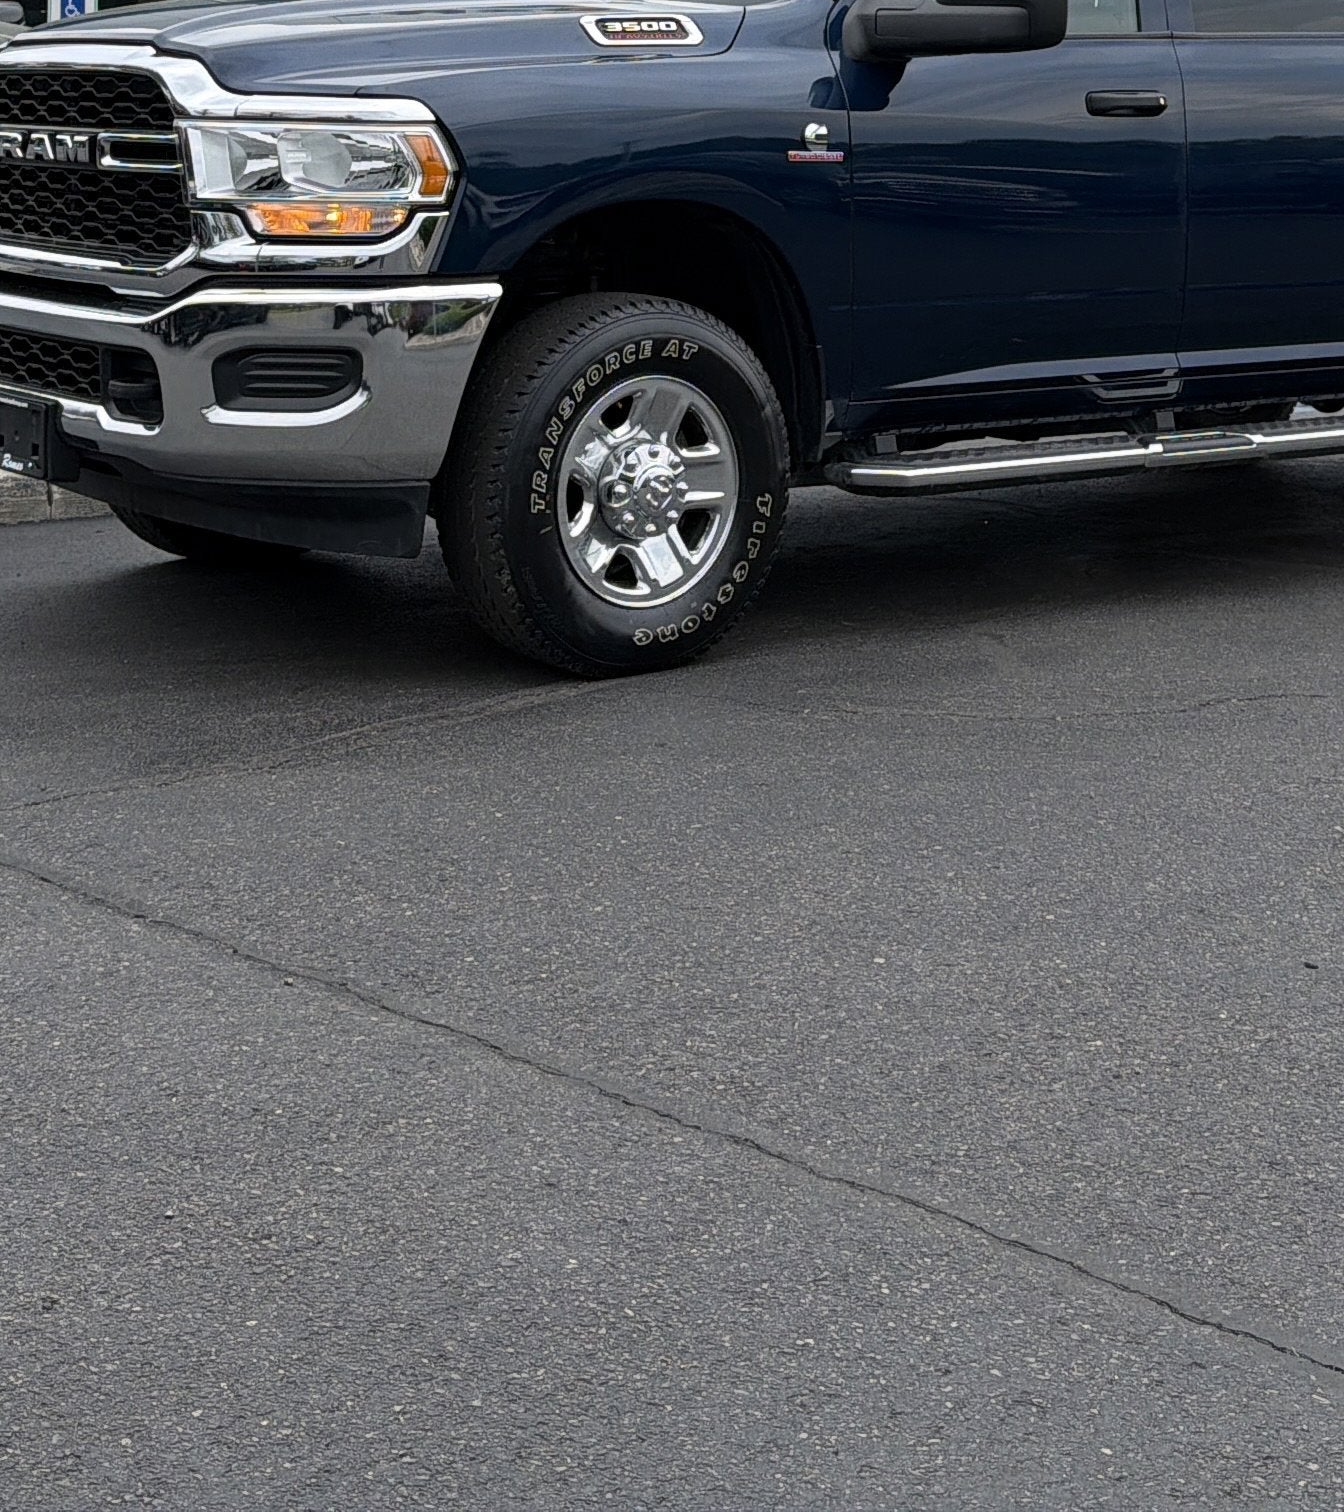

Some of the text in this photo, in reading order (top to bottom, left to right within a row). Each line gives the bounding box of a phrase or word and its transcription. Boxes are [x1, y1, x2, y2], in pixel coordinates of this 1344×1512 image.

[603, 21, 678, 32] 3500
[530, 339, 699, 514] TRANSFORCE AT
[632, 493, 773, 646] Firestone
